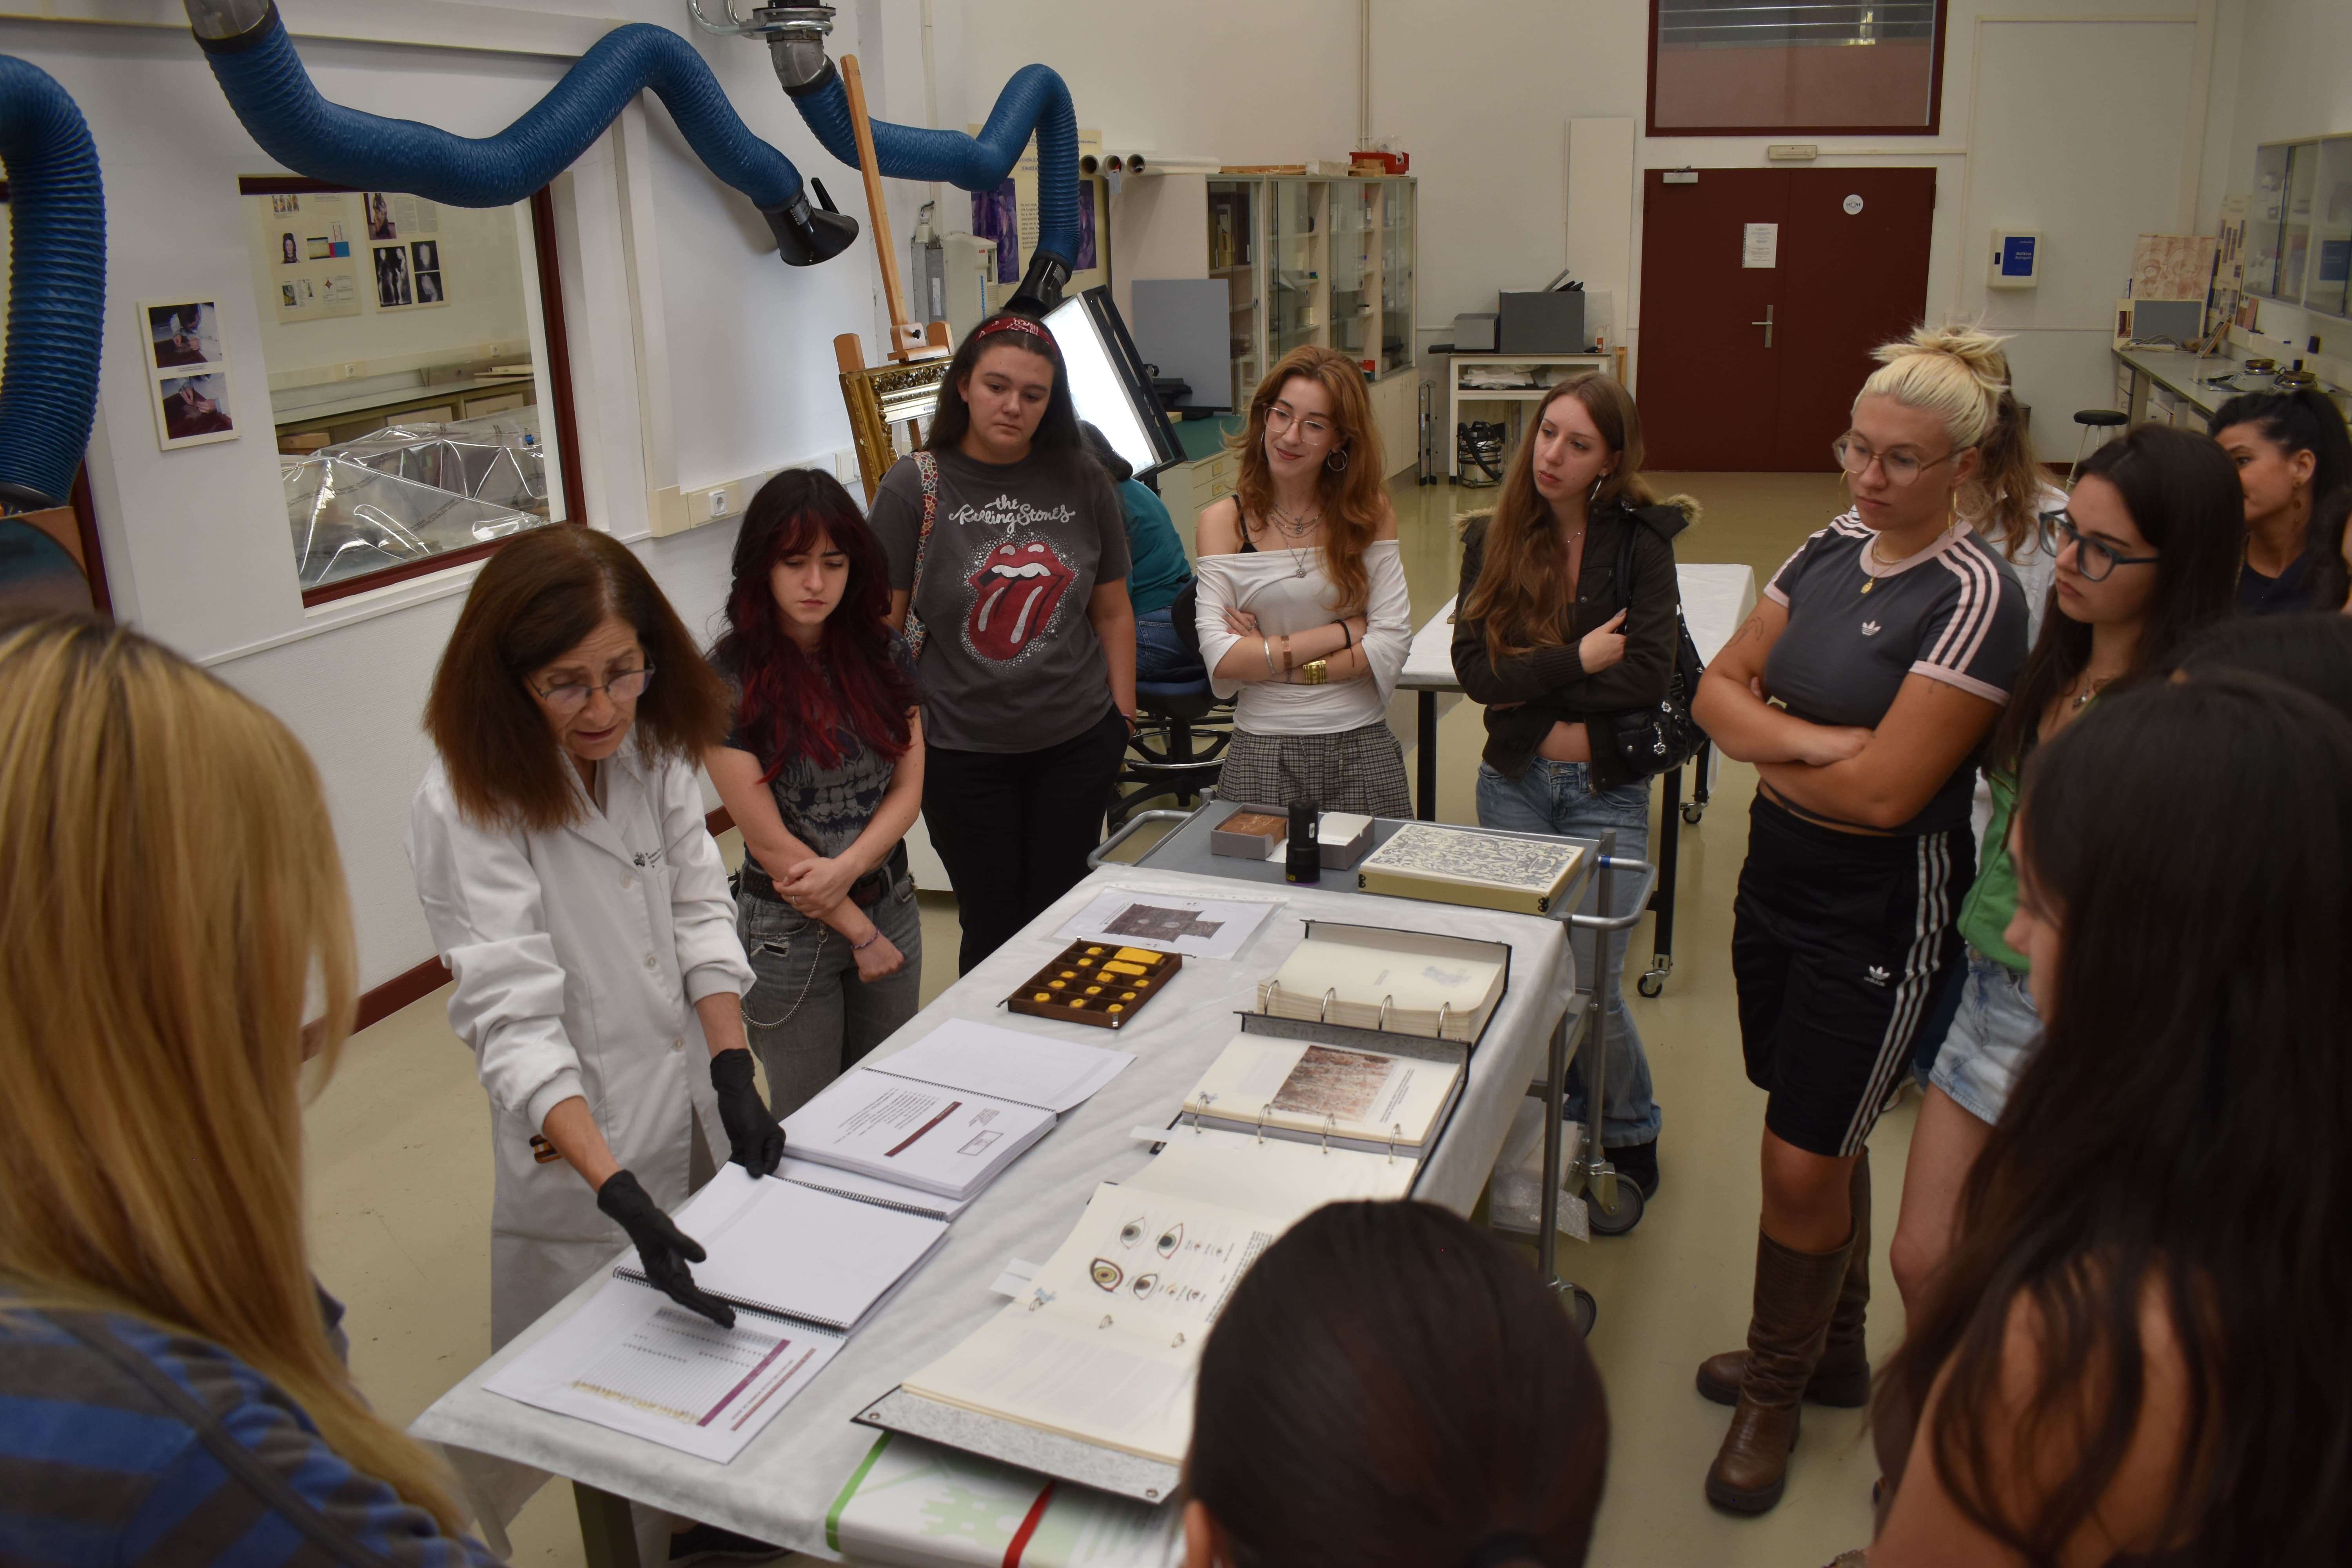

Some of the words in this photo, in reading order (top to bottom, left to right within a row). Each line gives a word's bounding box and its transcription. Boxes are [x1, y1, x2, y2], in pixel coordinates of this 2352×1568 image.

[985, 494, 1020, 510] the
[949, 504, 1020, 534] Rolling
[1017, 504, 1076, 526] Stones
